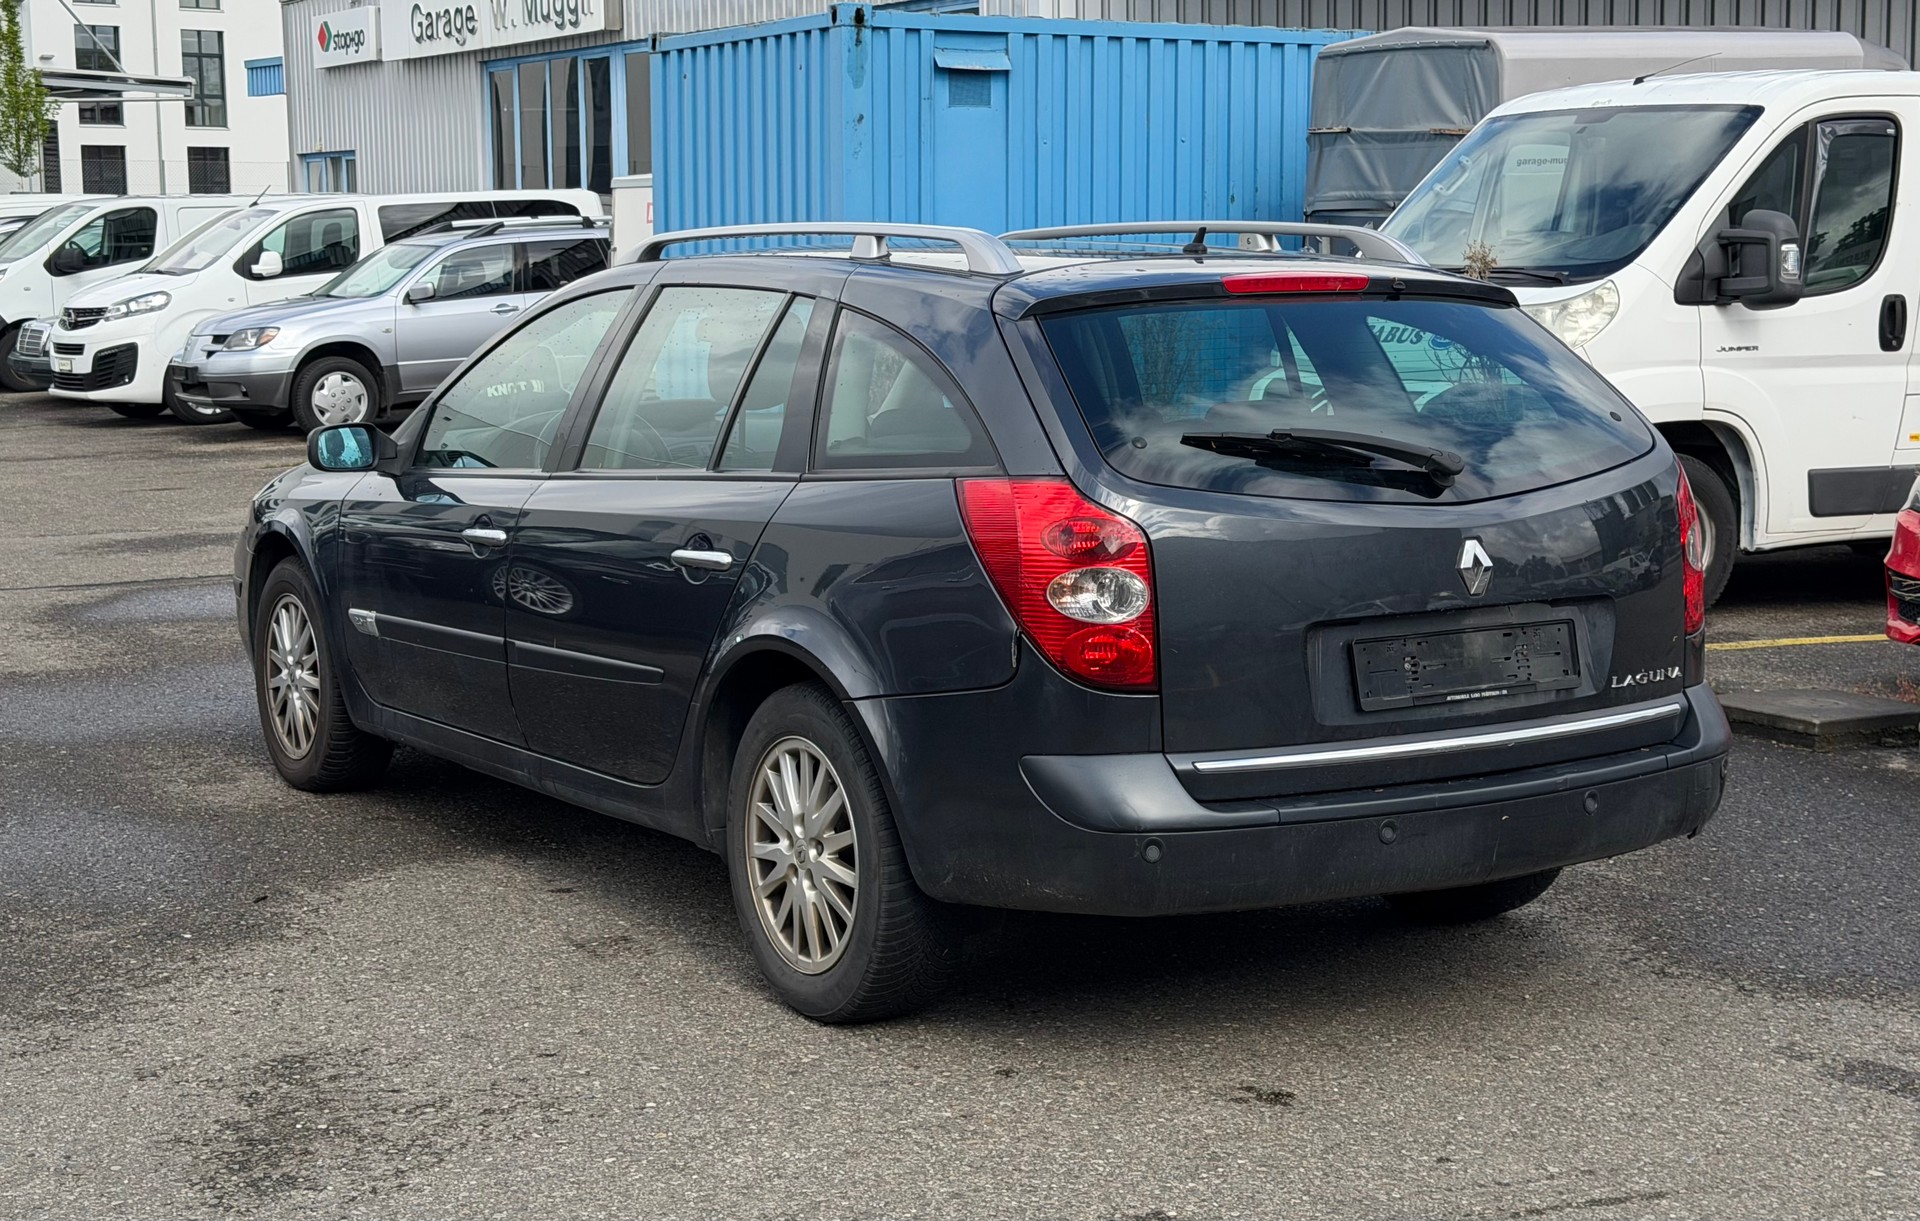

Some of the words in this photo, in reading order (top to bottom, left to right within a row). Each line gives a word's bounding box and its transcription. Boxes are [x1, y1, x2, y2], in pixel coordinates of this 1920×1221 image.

[411, 3, 478, 46] Garage
[333, 29, 365, 55] stop+go
[1369, 325, 1426, 345] ABUS
[1611, 666, 1683, 688] LAGUNA
